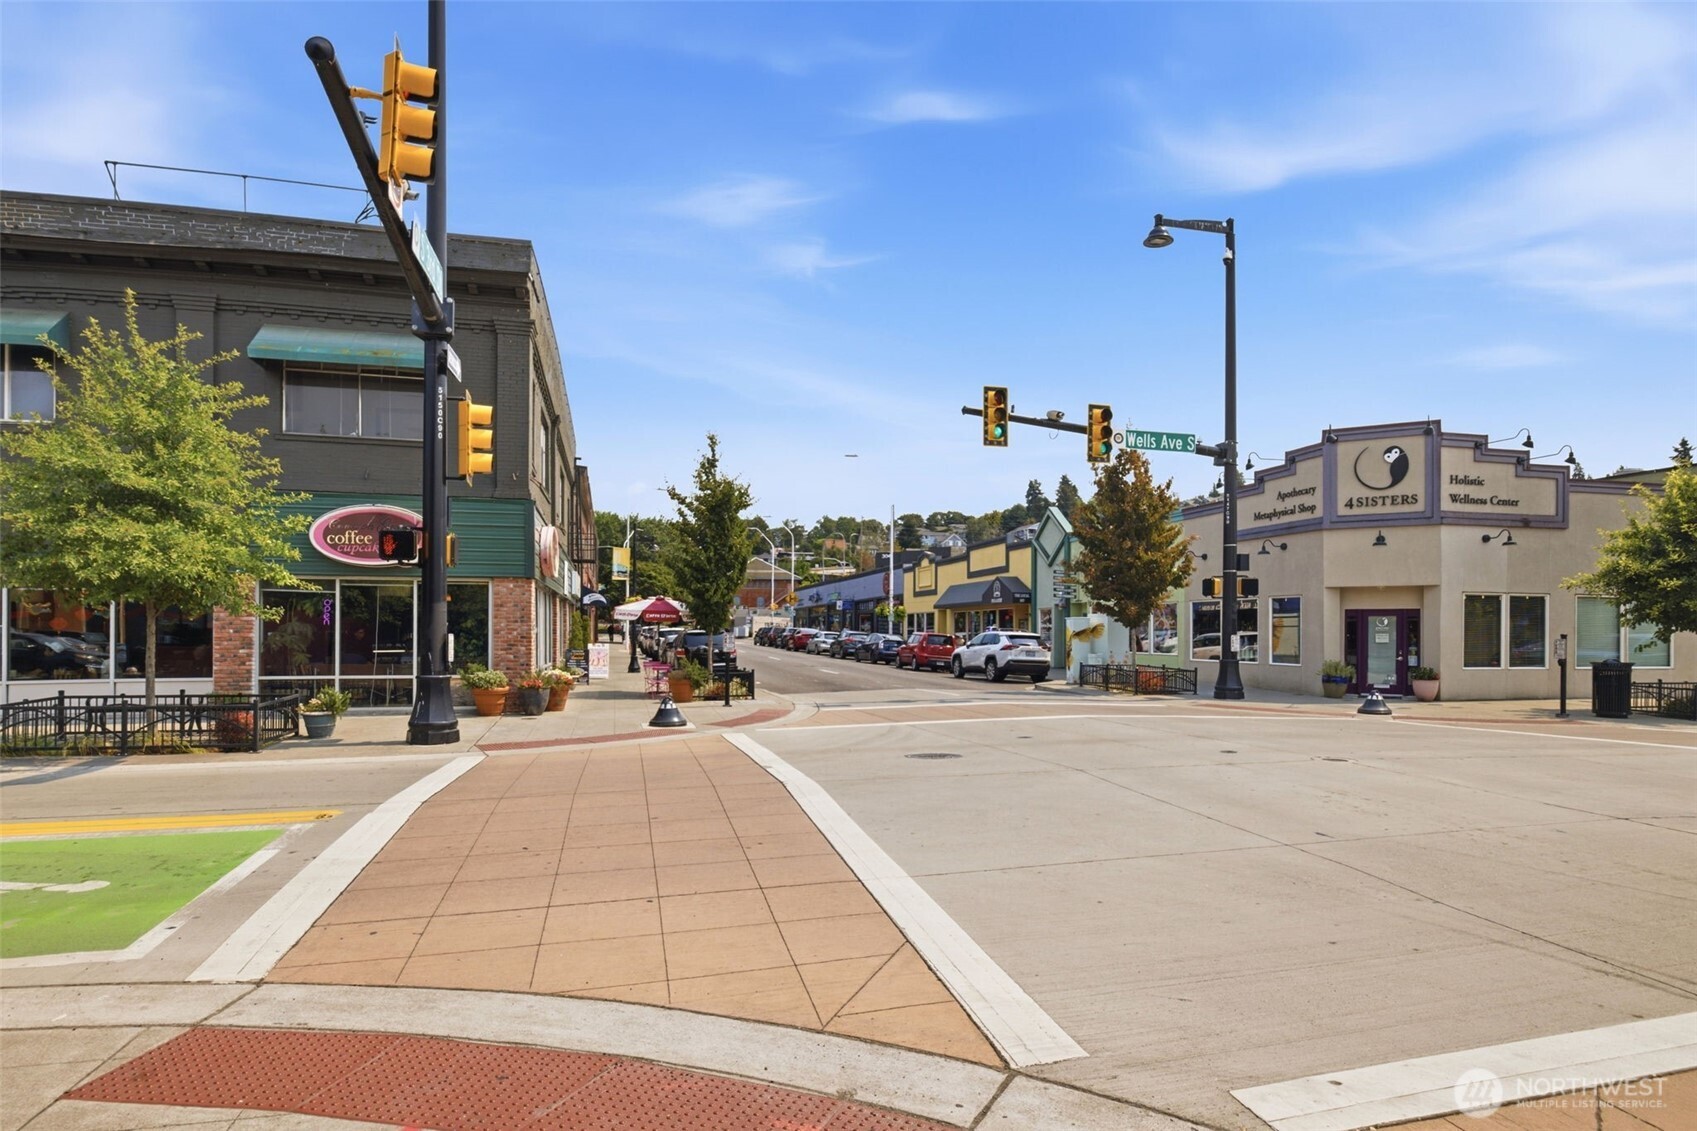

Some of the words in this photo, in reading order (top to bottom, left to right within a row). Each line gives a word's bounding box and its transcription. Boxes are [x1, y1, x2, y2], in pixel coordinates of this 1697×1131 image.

[1127, 432, 1156, 448] Wells
[1161, 434, 1183, 450] Ave
[1187, 435, 1195, 451] S
[1449, 475, 1485, 487] Holistic
[1276, 485, 1316, 501] Apothecary
[1449, 493, 1488, 506] Wellness
[1490, 495, 1520, 507] Center
[1253, 505, 1296, 522] Metaphysical
[1297, 502, 1316, 517] Shop
[326, 530, 373, 544] coffee
[323, 598, 332, 626] open
